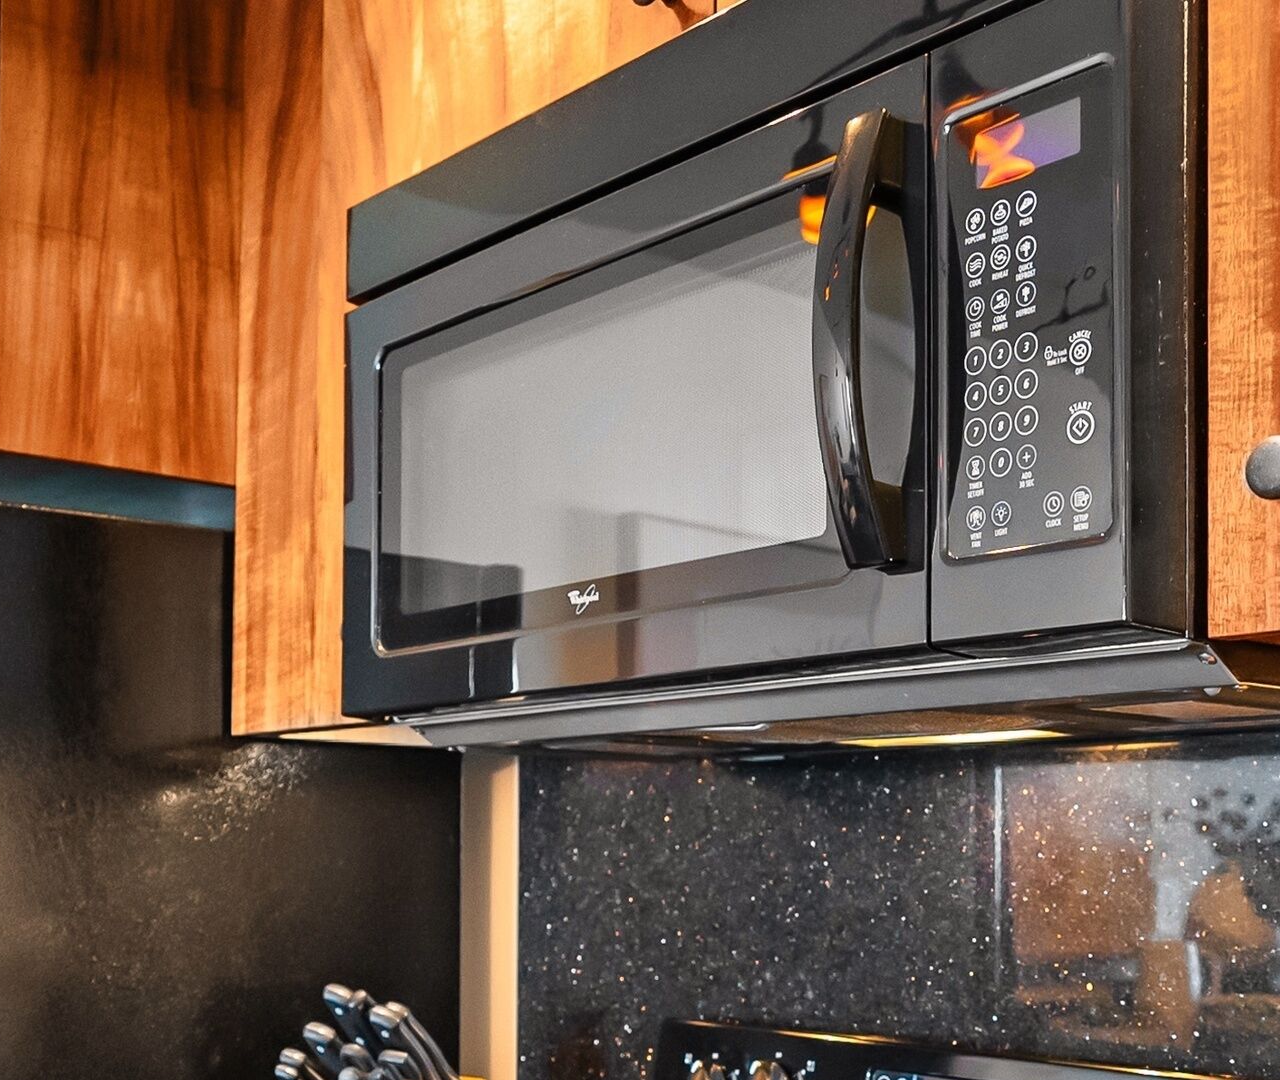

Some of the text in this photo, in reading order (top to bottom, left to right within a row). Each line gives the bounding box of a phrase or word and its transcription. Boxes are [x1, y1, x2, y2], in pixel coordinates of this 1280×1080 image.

[968, 277, 982, 289] COOK
[1068, 329, 1092, 343] CANCEL
[1023, 341, 1031, 353] 3
[997, 348, 1005, 360] 2
[973, 355, 979, 367] 1
[1023, 377, 1031, 390] 6
[972, 390, 980, 402] 4
[997, 384, 1005, 396] 5
[1068, 400, 1093, 415] START
[997, 420, 1005, 432] 8
[1023, 414, 1031, 427] 9
[973, 426, 980, 438] 7
[998, 456, 1005, 468] 0
[1045, 518, 1062, 529] CLOCK
